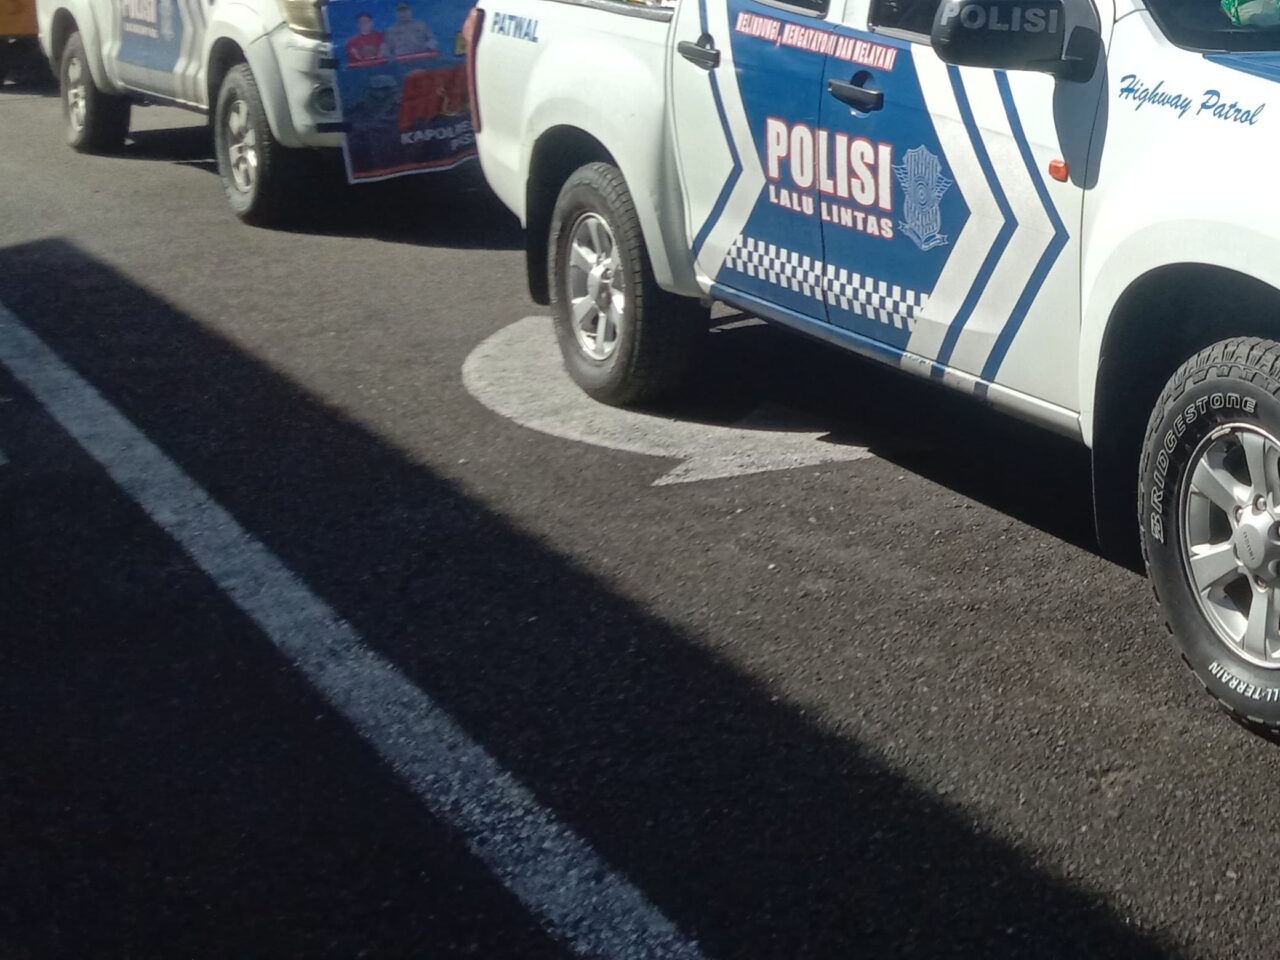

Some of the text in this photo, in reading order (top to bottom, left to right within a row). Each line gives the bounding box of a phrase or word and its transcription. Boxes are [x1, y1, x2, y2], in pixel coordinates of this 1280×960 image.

[491, 11, 539, 43] PATWAL
[940, 3, 1058, 34] POLISI
[1117, 73, 1266, 125] Highway Patrol
[766, 116, 893, 211] POLISI
[769, 184, 893, 239] LALU LINTAS
[1149, 391, 1258, 545] BRIDGESTONE
